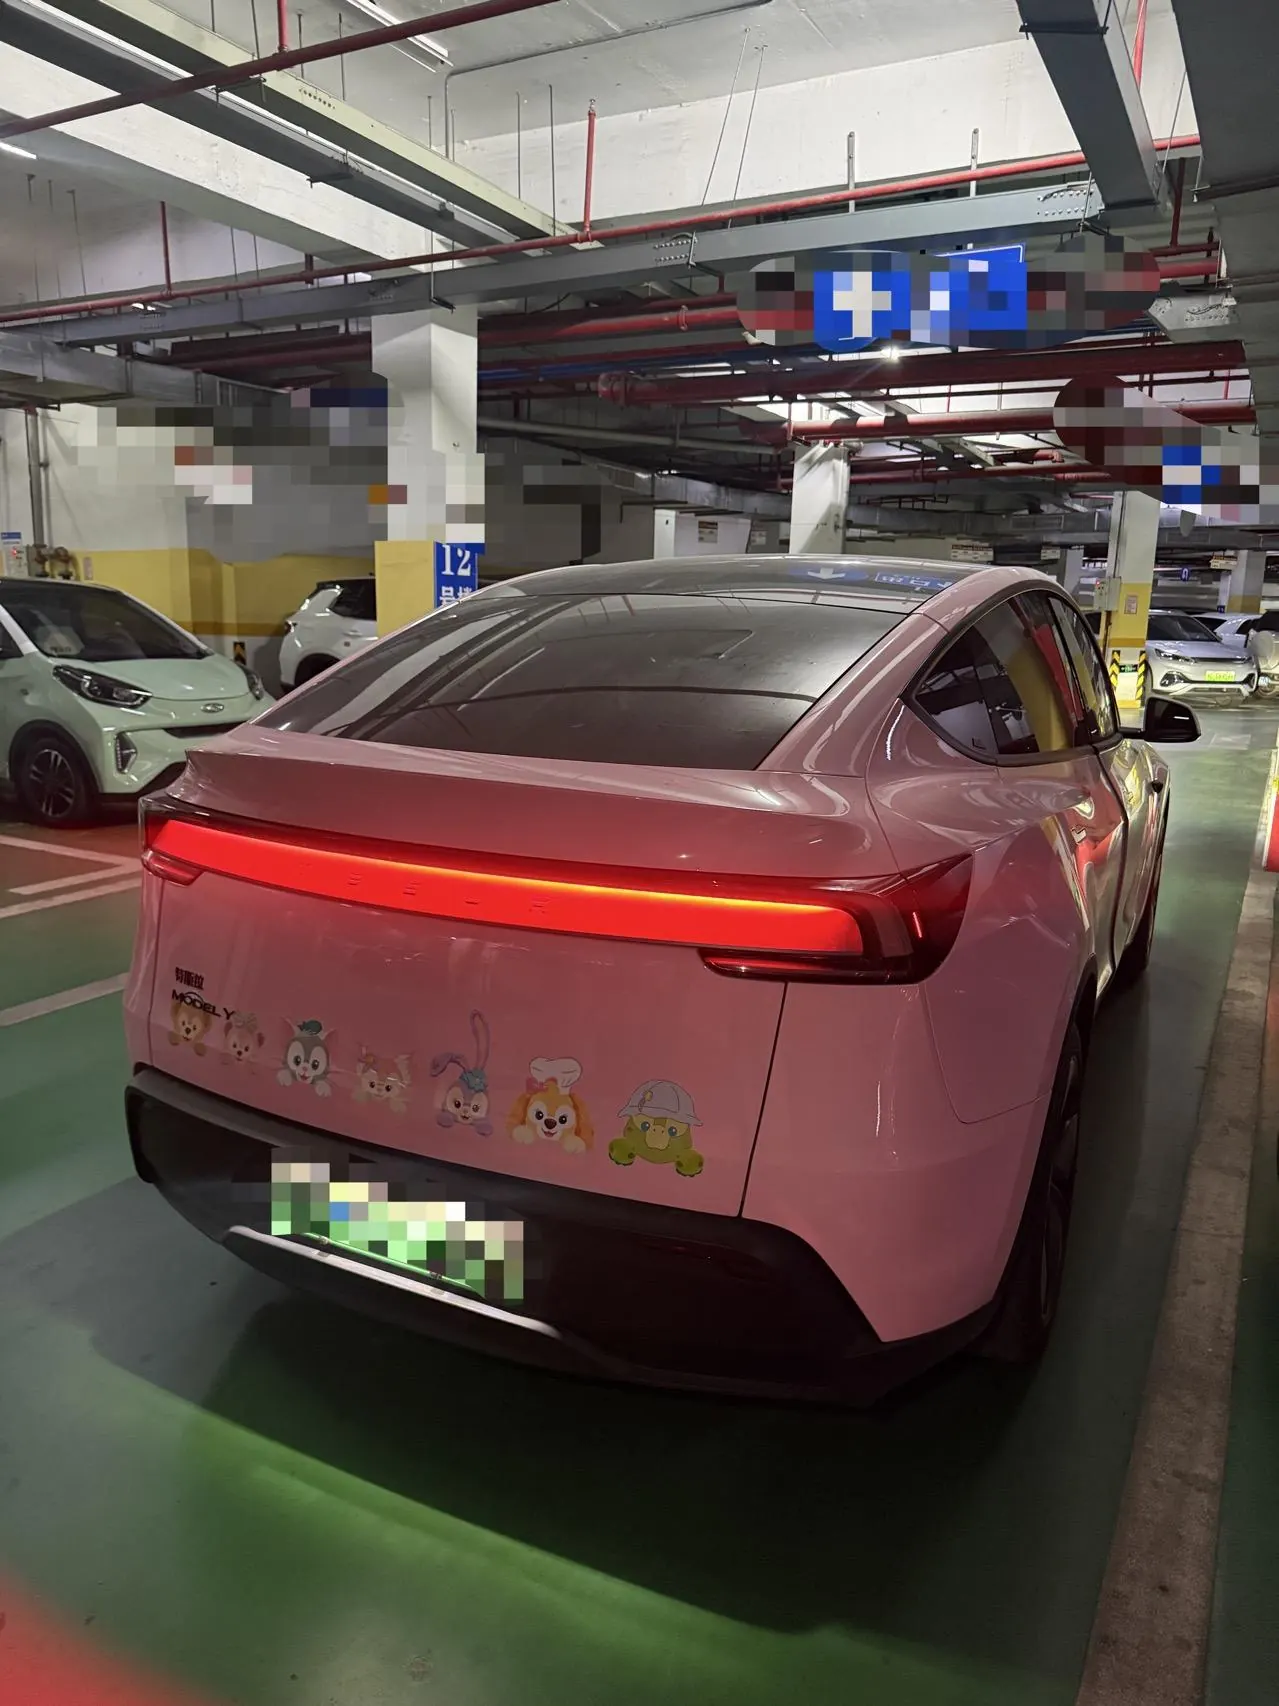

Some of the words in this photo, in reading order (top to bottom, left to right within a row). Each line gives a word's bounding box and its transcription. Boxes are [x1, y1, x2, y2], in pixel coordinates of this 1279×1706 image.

[441, 544, 471, 576] 12
[172, 989, 221, 1017] MODEL
[223, 1007, 236, 1020] Y
